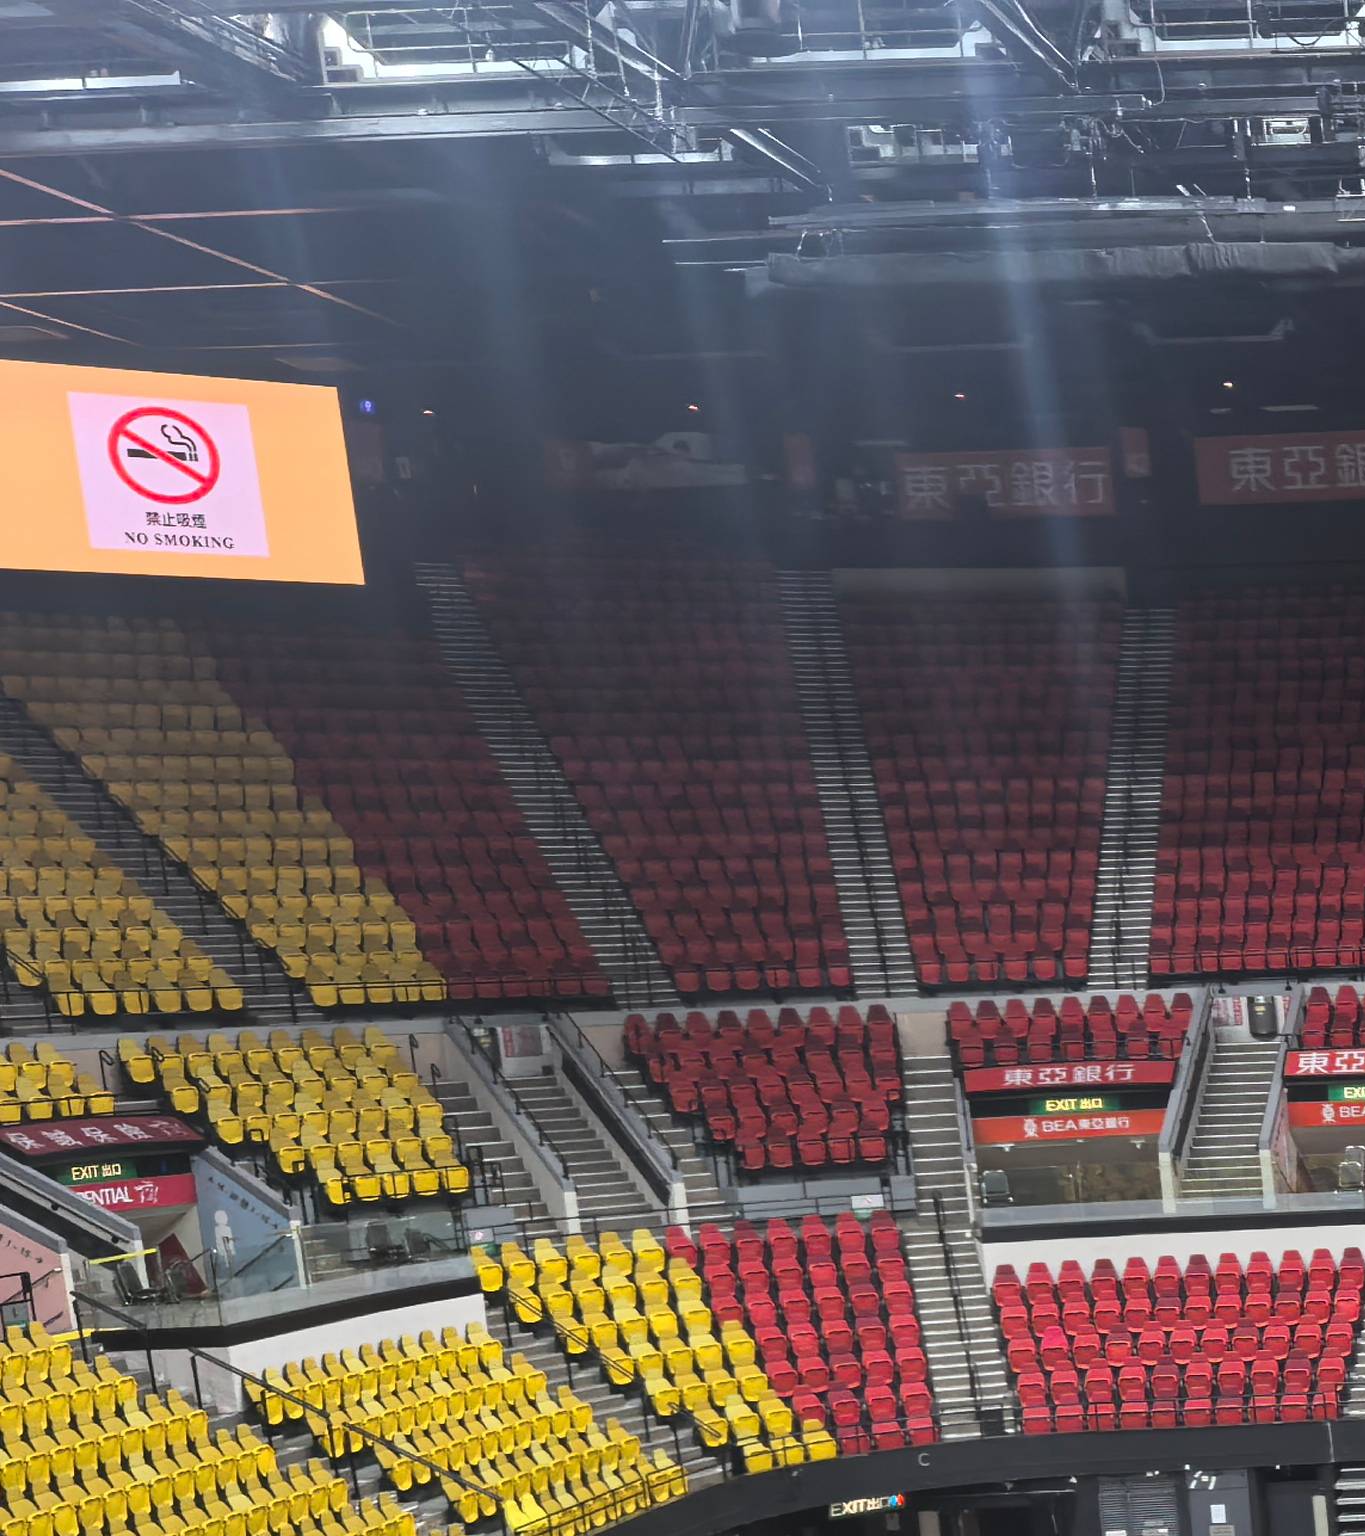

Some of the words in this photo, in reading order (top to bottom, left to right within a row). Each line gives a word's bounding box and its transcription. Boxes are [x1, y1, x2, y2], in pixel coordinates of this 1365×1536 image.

[145, 511, 207, 529] 禁止吸煙
[125, 531, 148, 546] NO
[155, 533, 235, 550] SMOKING
[1003, 1064, 1135, 1086] 東亞銀行
[1045, 1099, 1078, 1112] EXIT
[1080, 1098, 1103, 1109] 出口
[1042, 1120, 1077, 1132] BEA
[71, 1164, 99, 1180] EXIT
[101, 1163, 121, 1177] 出口
[918, 1453, 931, 1467] C
[831, 1499, 867, 1517] EXIT
